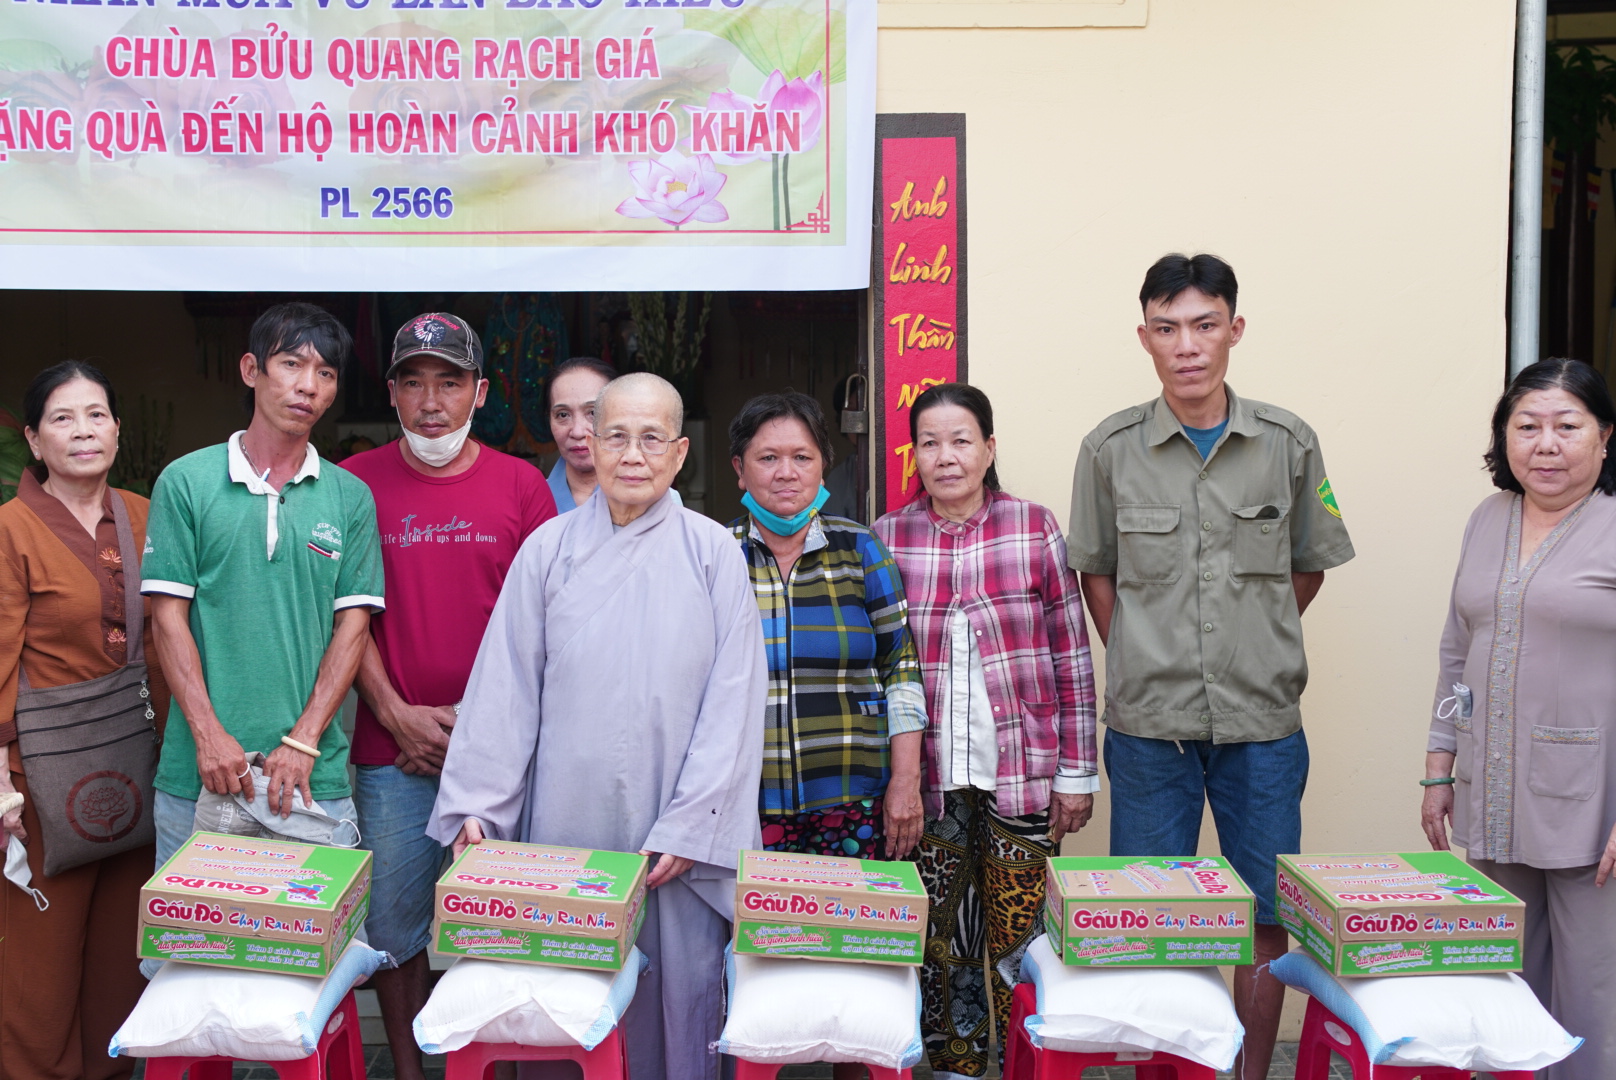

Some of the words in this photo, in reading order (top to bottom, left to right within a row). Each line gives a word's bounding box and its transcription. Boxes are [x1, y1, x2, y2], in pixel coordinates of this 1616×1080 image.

[106, 27, 217, 79] CHÙA
[231, 22, 313, 80] BỬU
[327, 38, 460, 87] QUANG
[474, 38, 581, 87] RẠCH
[595, 27, 660, 80] GIÁ
[86, 99, 168, 160] QUÀ
[181, 95, 263, 154] ĐẾN
[278, 101, 333, 162] HỘ
[348, 101, 457, 154] HOÀN
[471, 97, 579, 154] CẢNH
[593, 101, 677, 154] KHÓ
[691, 102, 801, 153] KHĂN
[320, 187, 359, 219] PL
[371, 186, 454, 219] 2566
[889, 175, 950, 223] Anh
[889, 242, 952, 285] Linh
[888, 312, 957, 356] Thần
[436, 534, 450, 544] ups
[454, 532, 471, 542] and
[475, 532, 497, 543] downs
[217, 801, 234, 833] NGELES
[148, 898, 193, 920] Gấu
[194, 904, 224, 924] Đỏ
[442, 894, 486, 916] Gấu
[487, 898, 517, 920] Đỏ
[744, 891, 787, 912] Gấu
[789, 895, 819, 915] Đỏ
[824, 902, 856, 920] Chay
[859, 904, 886, 921] Rau
[889, 906, 918, 922] Nấm
[228, 913, 260, 931] Chay
[264, 916, 290, 932] Rau
[293, 918, 323, 936] Nấm
[522, 906, 554, 926] Chay
[557, 910, 583, 926] Rau
[586, 912, 616, 930] Nấm
[1073, 908, 1118, 930] Gấu
[1120, 909, 1150, 930] Đỏ
[1154, 914, 1186, 931] Chay
[1188, 914, 1216, 928] Rau
[1217, 911, 1246, 928] Nấm
[1345, 913, 1388, 933] Gấu
[1390, 913, 1418, 933] Đỏ
[1423, 917, 1454, 934] Chay
[1458, 917, 1483, 930] Rau
[1486, 914, 1516, 930] Nấm
